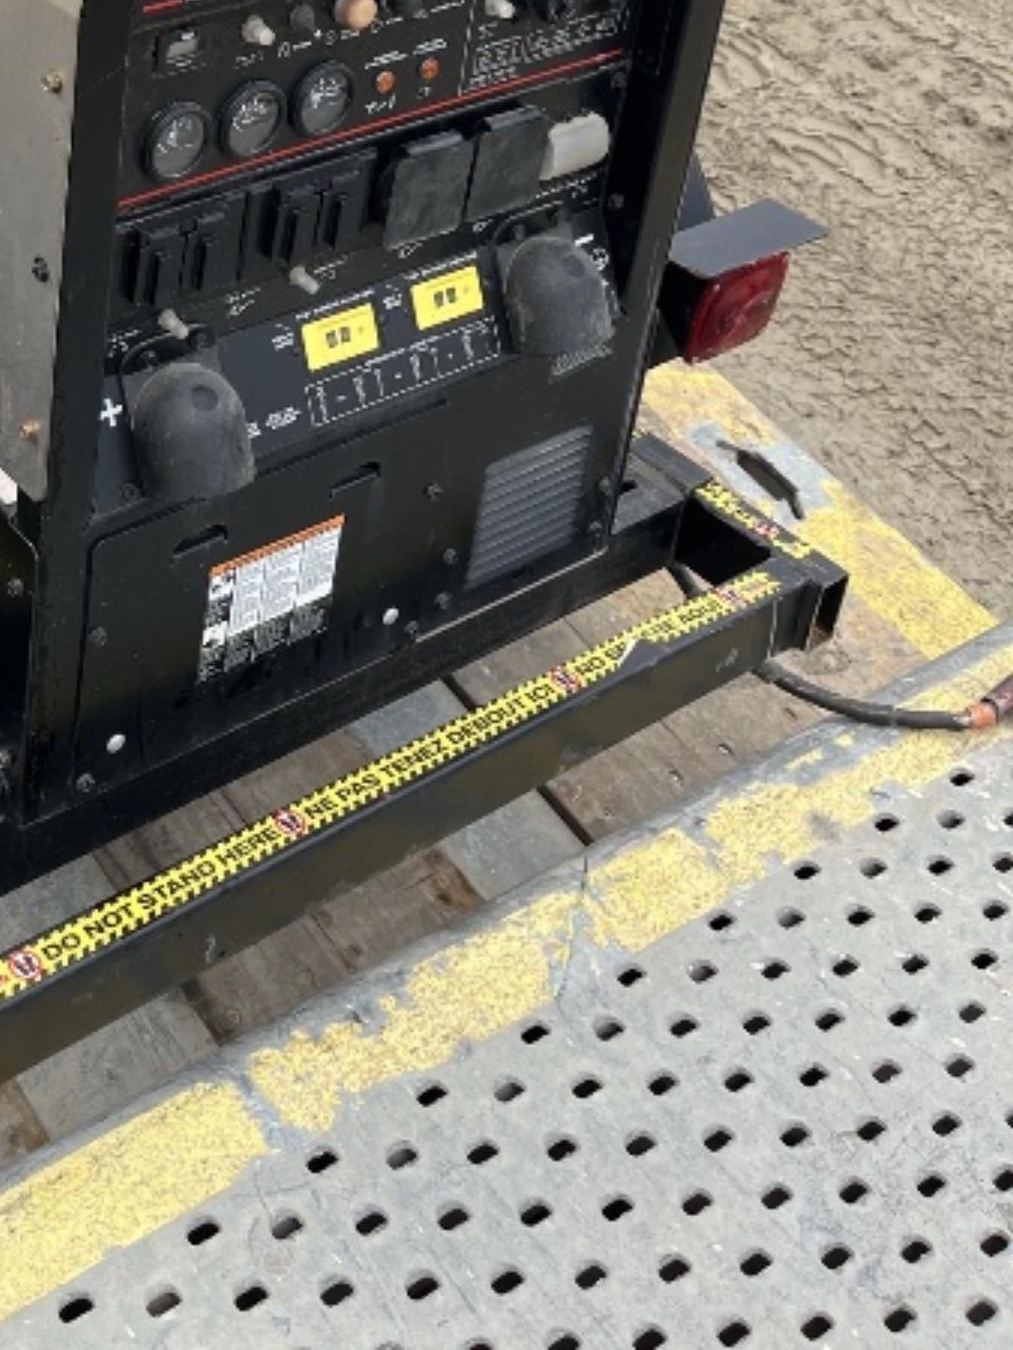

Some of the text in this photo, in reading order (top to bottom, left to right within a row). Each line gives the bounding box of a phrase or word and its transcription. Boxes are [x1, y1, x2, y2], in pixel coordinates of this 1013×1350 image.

[304, 682, 556, 818] NE PAS TENEZ DEBOUT ICI
[41, 826, 279, 961] DO NOT STAND HERE
